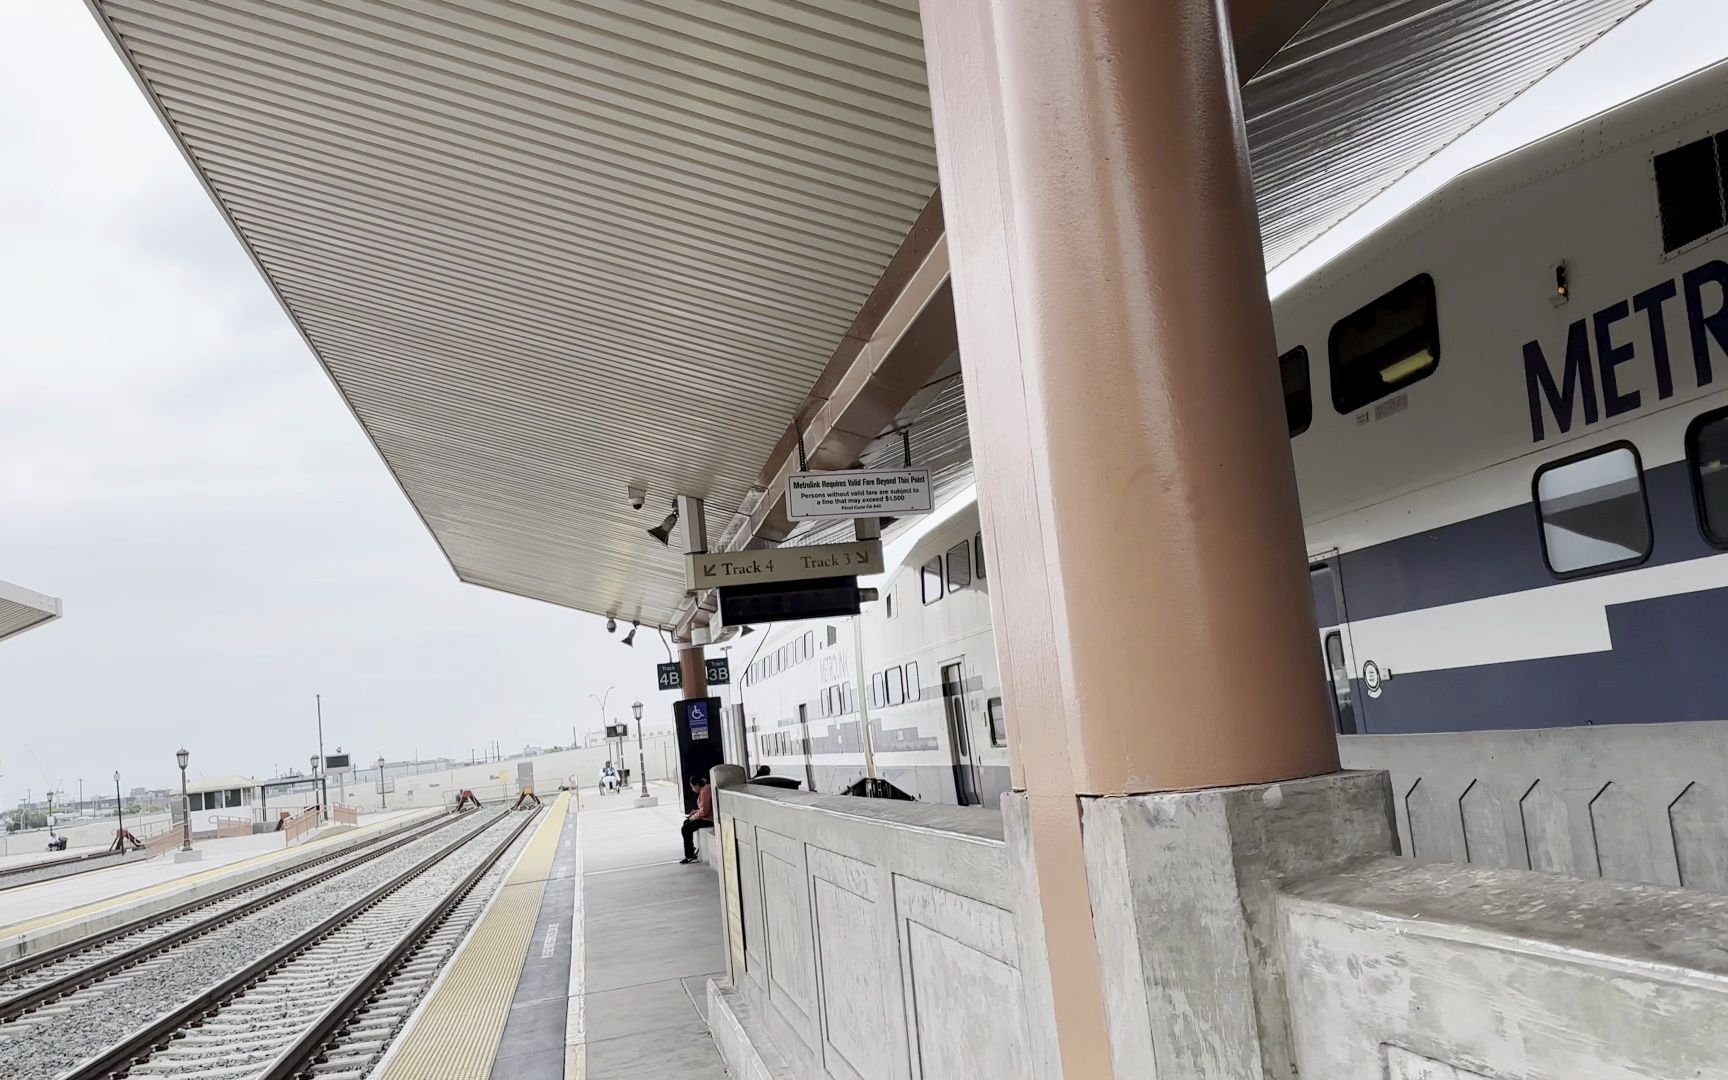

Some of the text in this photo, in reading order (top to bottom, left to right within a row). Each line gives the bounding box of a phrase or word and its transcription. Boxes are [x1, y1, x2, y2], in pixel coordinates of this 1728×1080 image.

[1522, 259, 1728, 443] METR
[793, 481, 820, 489] Metrolink
[876, 477, 896, 486] Beyond
[722, 560, 774, 576] Track 4
[800, 553, 851, 569] Track 3
[660, 672, 679, 685] 4B
[709, 668, 728, 681] 3B
